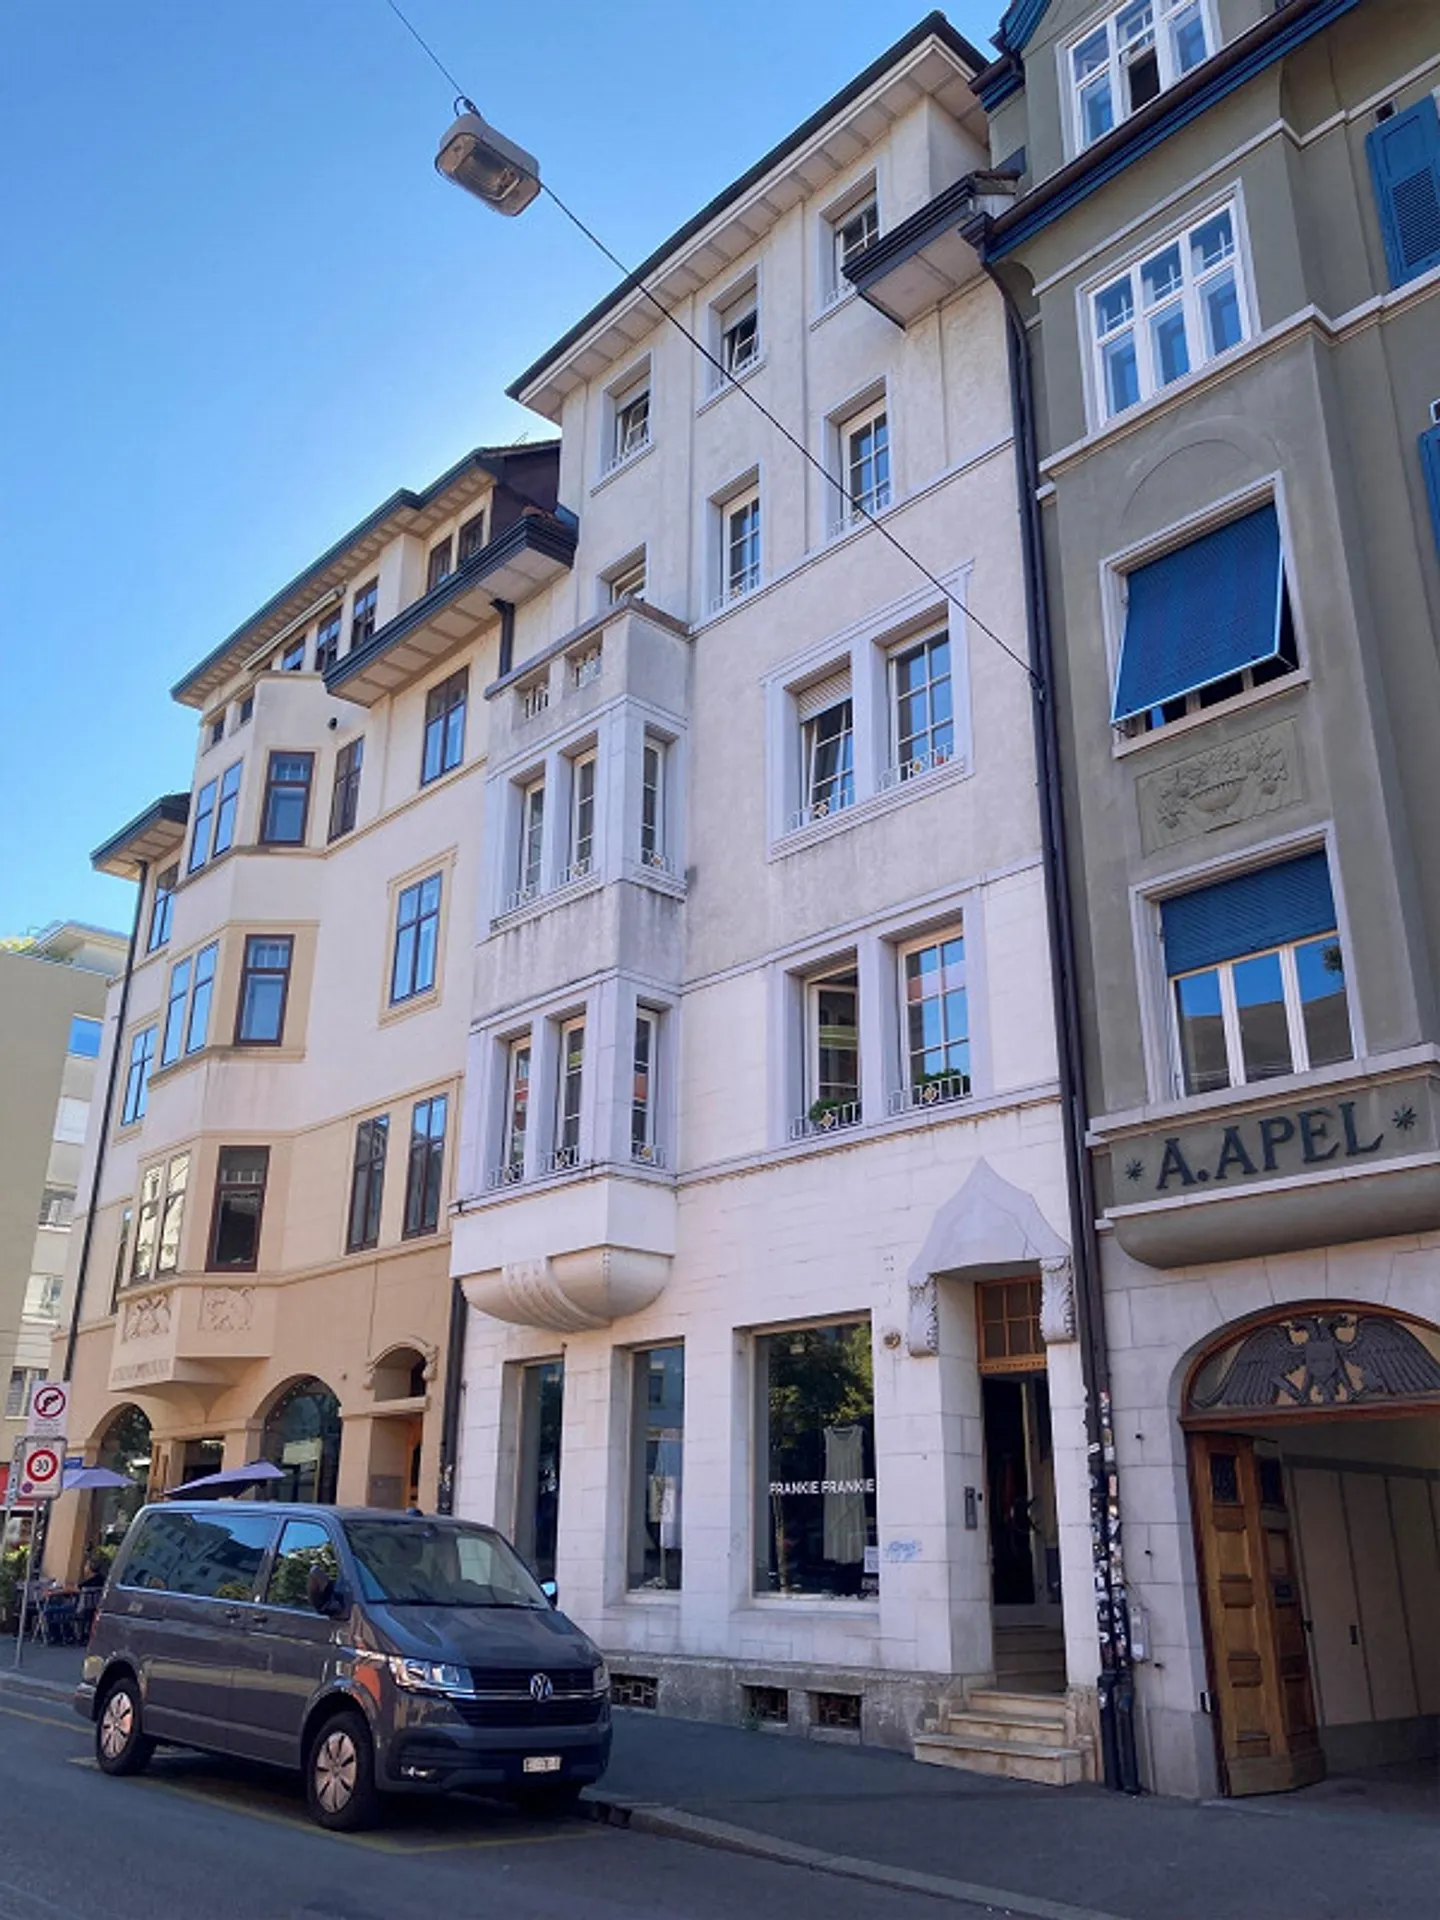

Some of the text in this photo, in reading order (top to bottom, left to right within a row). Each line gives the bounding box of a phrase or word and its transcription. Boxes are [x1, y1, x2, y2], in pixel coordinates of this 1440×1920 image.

[35, 1459, 49, 1472] 30
[770, 1479, 875, 1495] FRANKIE FRANKIE
